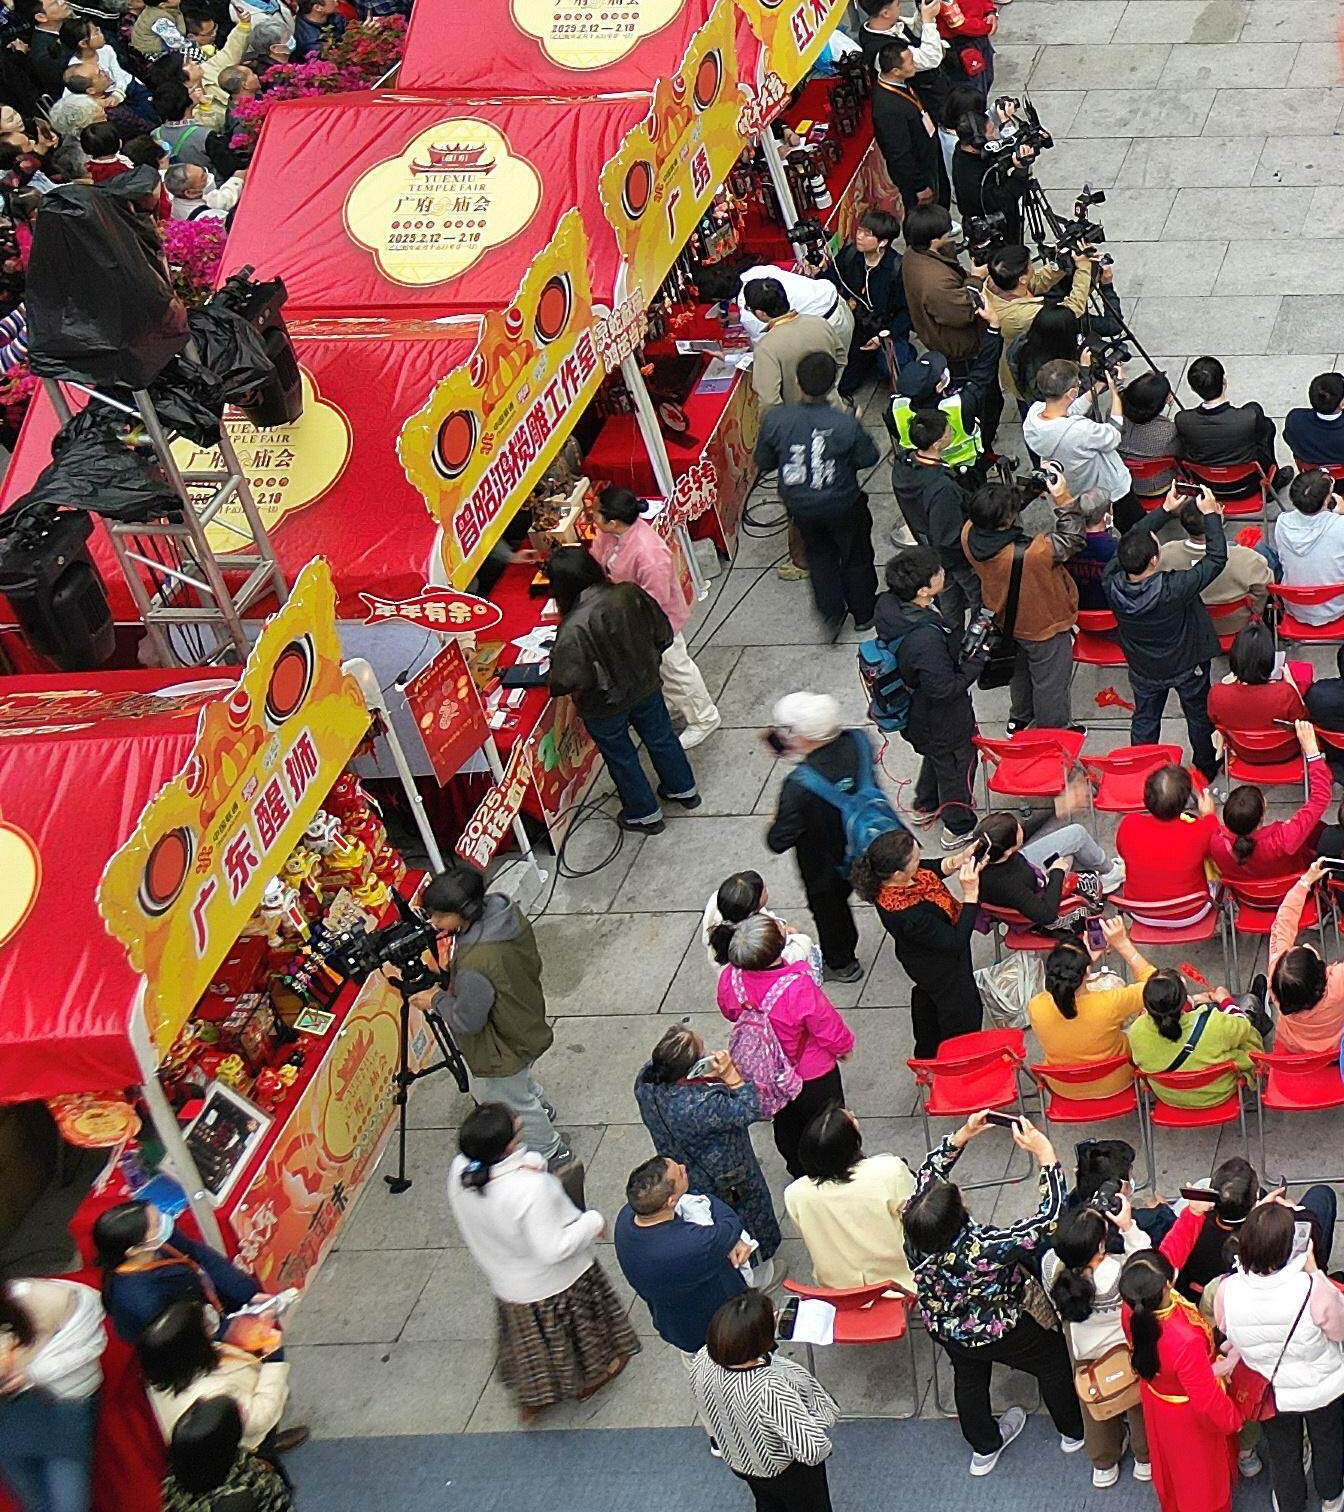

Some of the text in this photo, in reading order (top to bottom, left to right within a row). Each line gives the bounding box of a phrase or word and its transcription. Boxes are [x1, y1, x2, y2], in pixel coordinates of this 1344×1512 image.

[408, 184, 458, 192] TEMPLE
[424, 175, 476, 183] YUEXIU
[393, 195, 492, 213] 广府庙会
[667, 147, 712, 240] 广绣
[260, 434, 290, 443] FAIR
[456, 332, 597, 558] 曾昭鸿榄雕工作室
[374, 601, 472, 623] 年年有余
[458, 790, 502, 856] 2025
[193, 730, 319, 954] 广东醒狮
